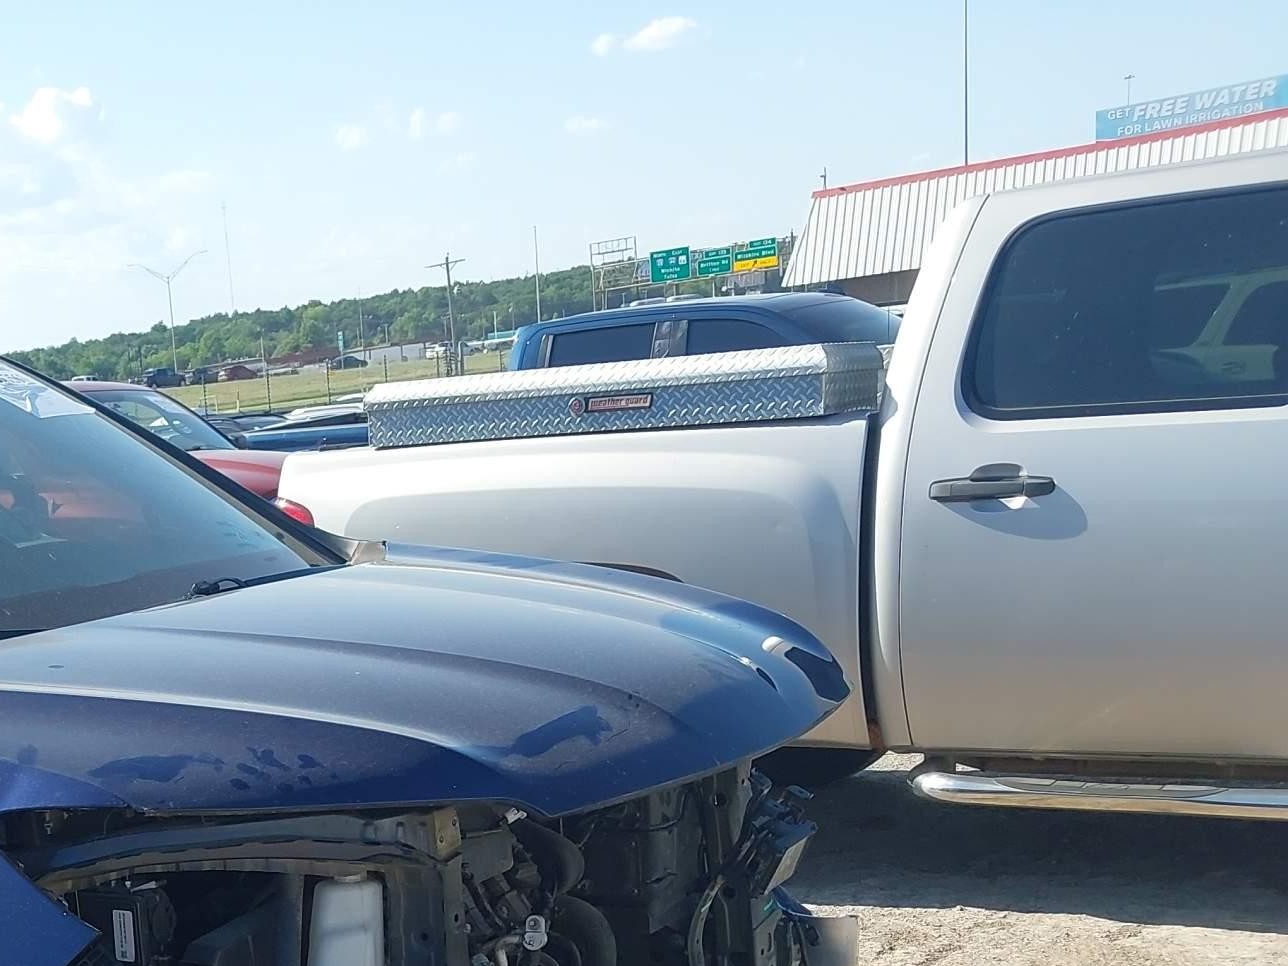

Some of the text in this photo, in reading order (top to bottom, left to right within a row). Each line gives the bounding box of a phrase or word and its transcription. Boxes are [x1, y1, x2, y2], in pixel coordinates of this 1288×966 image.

[1108, 79, 1278, 121] GET FREE WATER
[1117, 101, 1264, 137] FOR LAWN IRRIGATION
